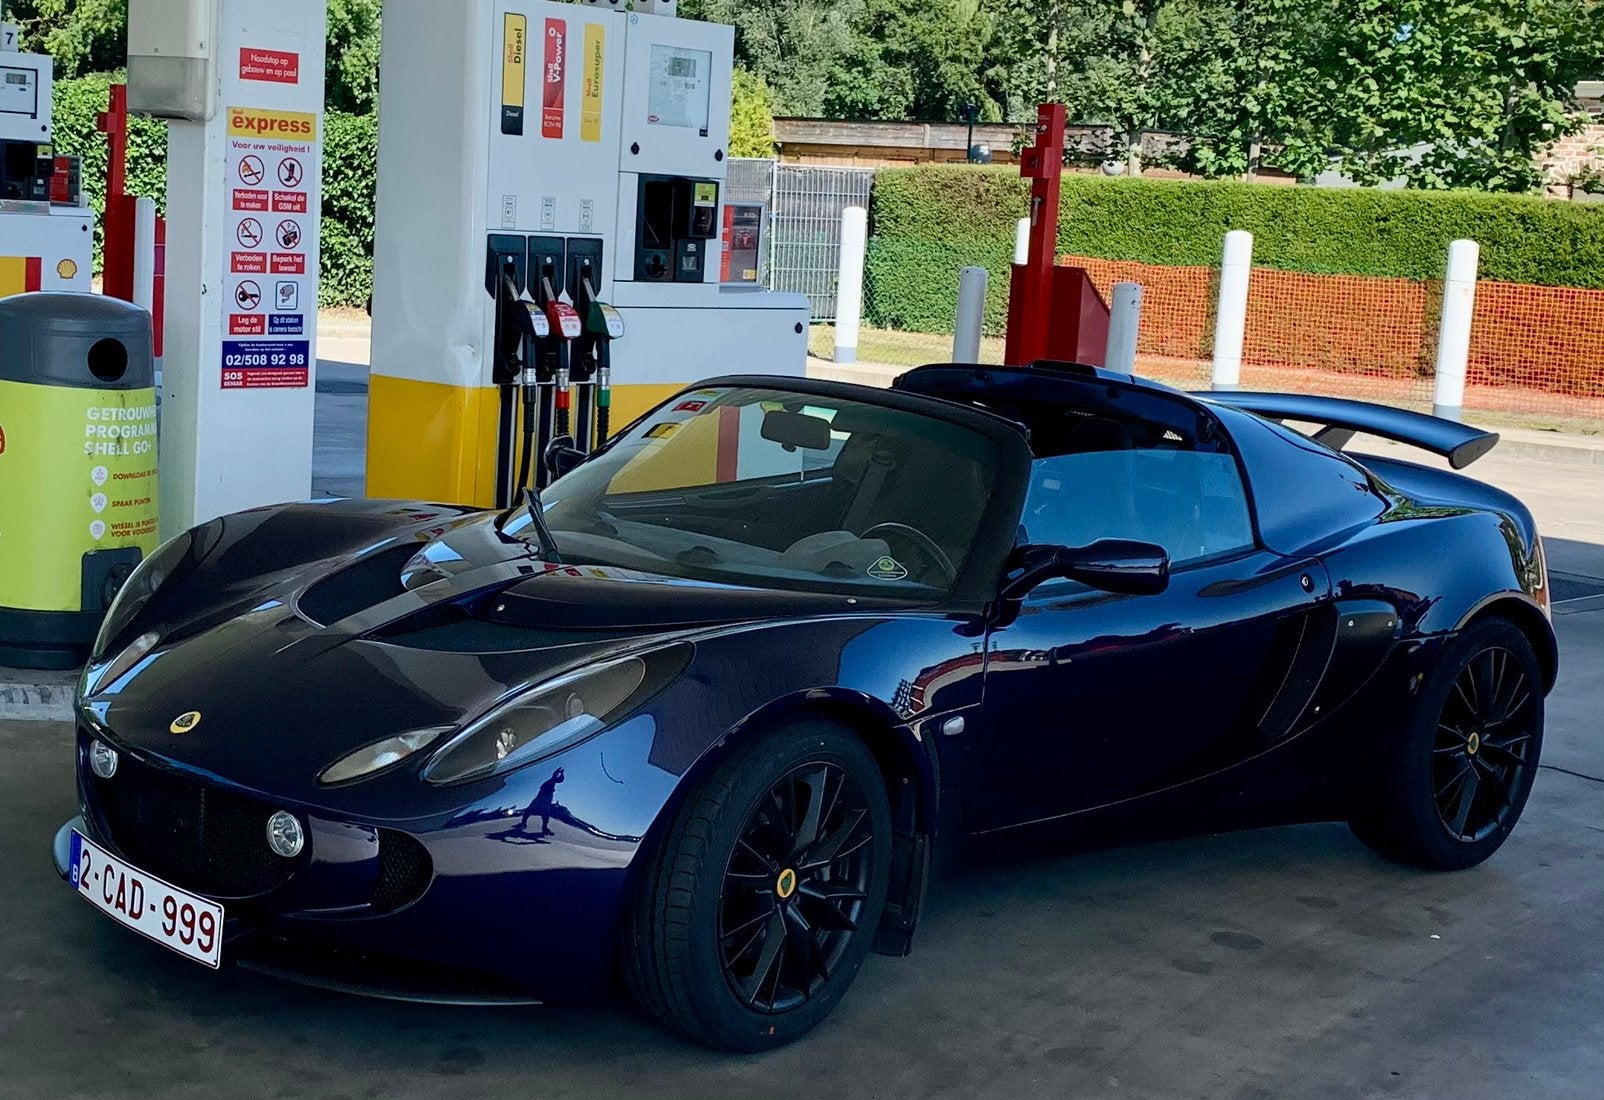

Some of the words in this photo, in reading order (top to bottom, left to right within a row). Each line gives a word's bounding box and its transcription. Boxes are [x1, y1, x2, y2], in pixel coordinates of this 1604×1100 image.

[5, 32, 14, 45] 7
[514, 28, 523, 64] Diesel
[250, 53, 280, 66] Noodstop
[553, 32, 563, 83] V-Power
[241, 63, 265, 75] gebouw
[274, 69, 283, 77] op
[283, 68, 297, 78] paal
[592, 40, 602, 98] Eurosuper
[232, 115, 311, 135] express
[232, 140, 252, 150] Voor
[253, 143, 266, 151] uw
[268, 143, 306, 154] veiligheid
[296, 194, 306, 202] de
[278, 202, 293, 211] GSM
[235, 254, 262, 262] Verboden
[294, 255, 303, 263] het
[250, 316, 258, 324] de
[233, 325, 252, 333] motor
[225, 354, 268, 367] 02/508
[270, 353, 287, 366] 92
[288, 353, 305, 366] 98
[223, 371, 244, 381] SOS
[84, 441, 130, 456] SHELL
[112, 499, 133, 508] SPAAR
[110, 529, 131, 538] VOOR
[71, 863, 79, 883] B
[80, 848, 216, 953] 2-CAD-999
